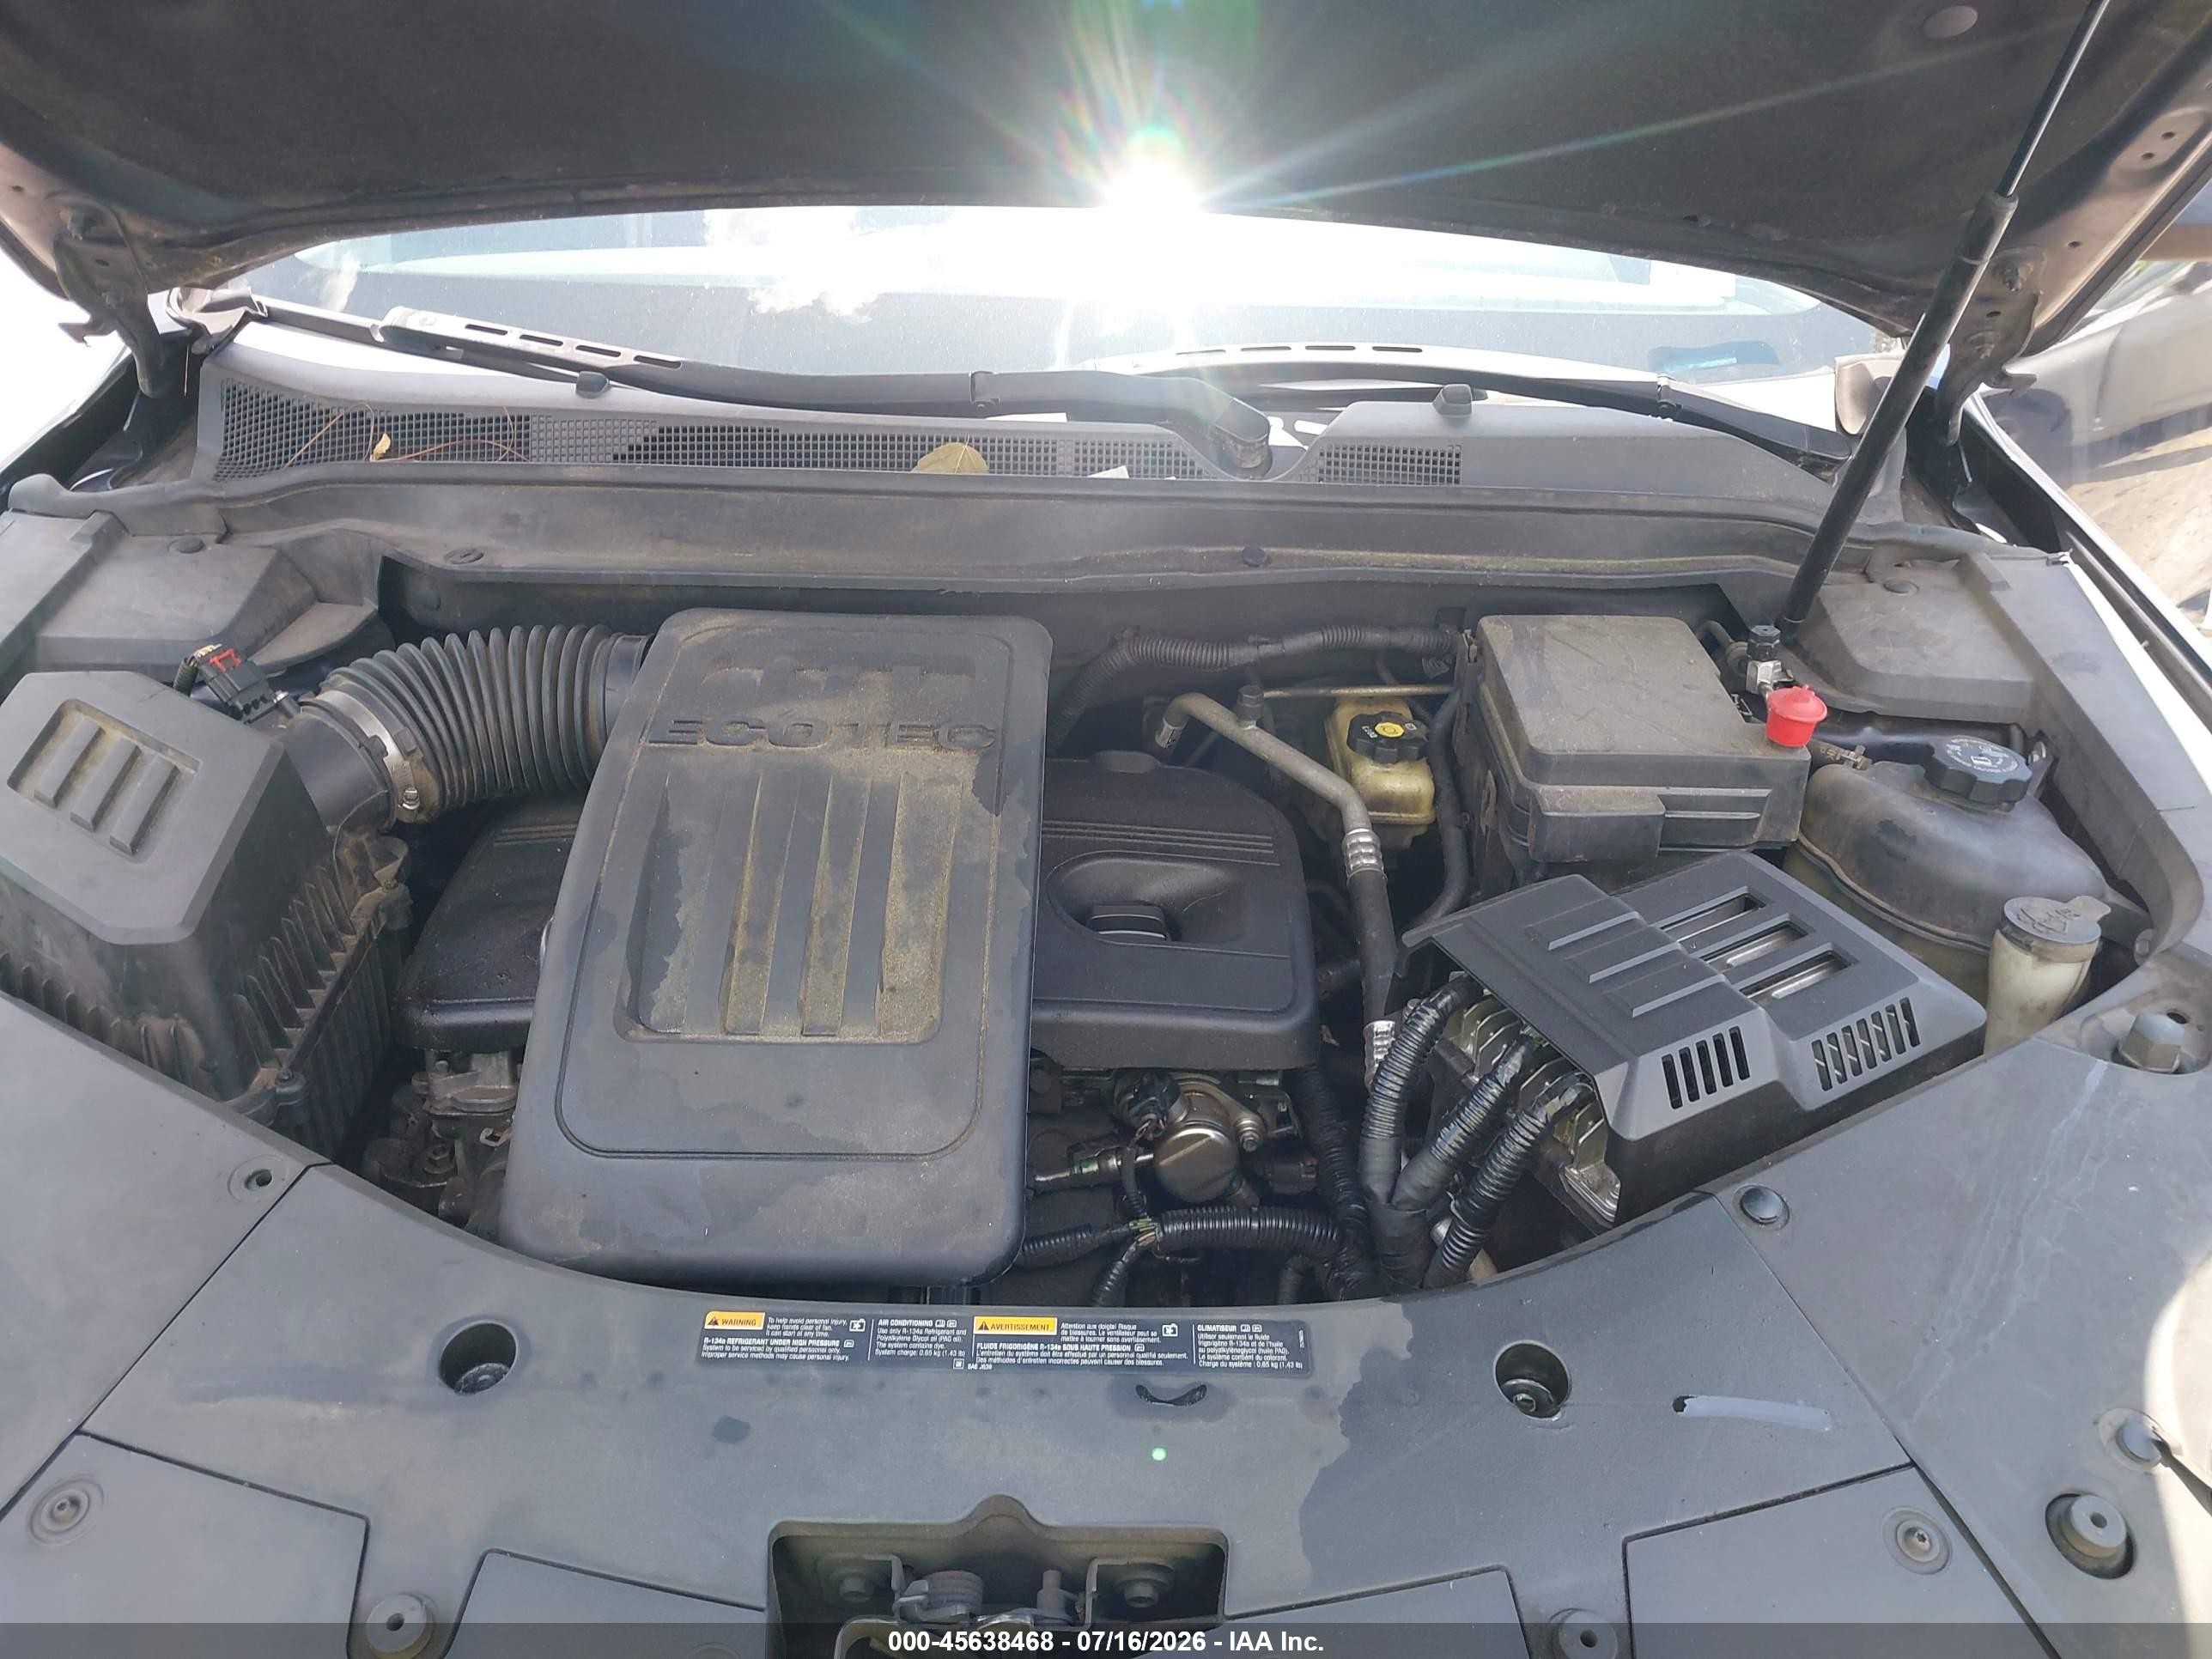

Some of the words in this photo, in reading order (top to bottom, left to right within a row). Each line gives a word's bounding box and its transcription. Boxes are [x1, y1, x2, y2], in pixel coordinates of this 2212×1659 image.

[648, 718, 998, 749] ECOTEC
[775, 1317, 787, 1326] help
[805, 1318, 830, 1327] personal
[889, 1328, 901, 1336] only
[702, 1344, 724, 1352] System
[765, 1345, 773, 1354] by
[774, 1346, 799, 1354] qualified
[799, 1346, 828, 1355] personnel
[887, 1341, 908, 1350] system
[806, 1353, 832, 1362] personal
[875, 1348, 896, 1357] System
[933, 1349, 941, 1358] kg
[1199, 1360, 1219, 1369] Charge
